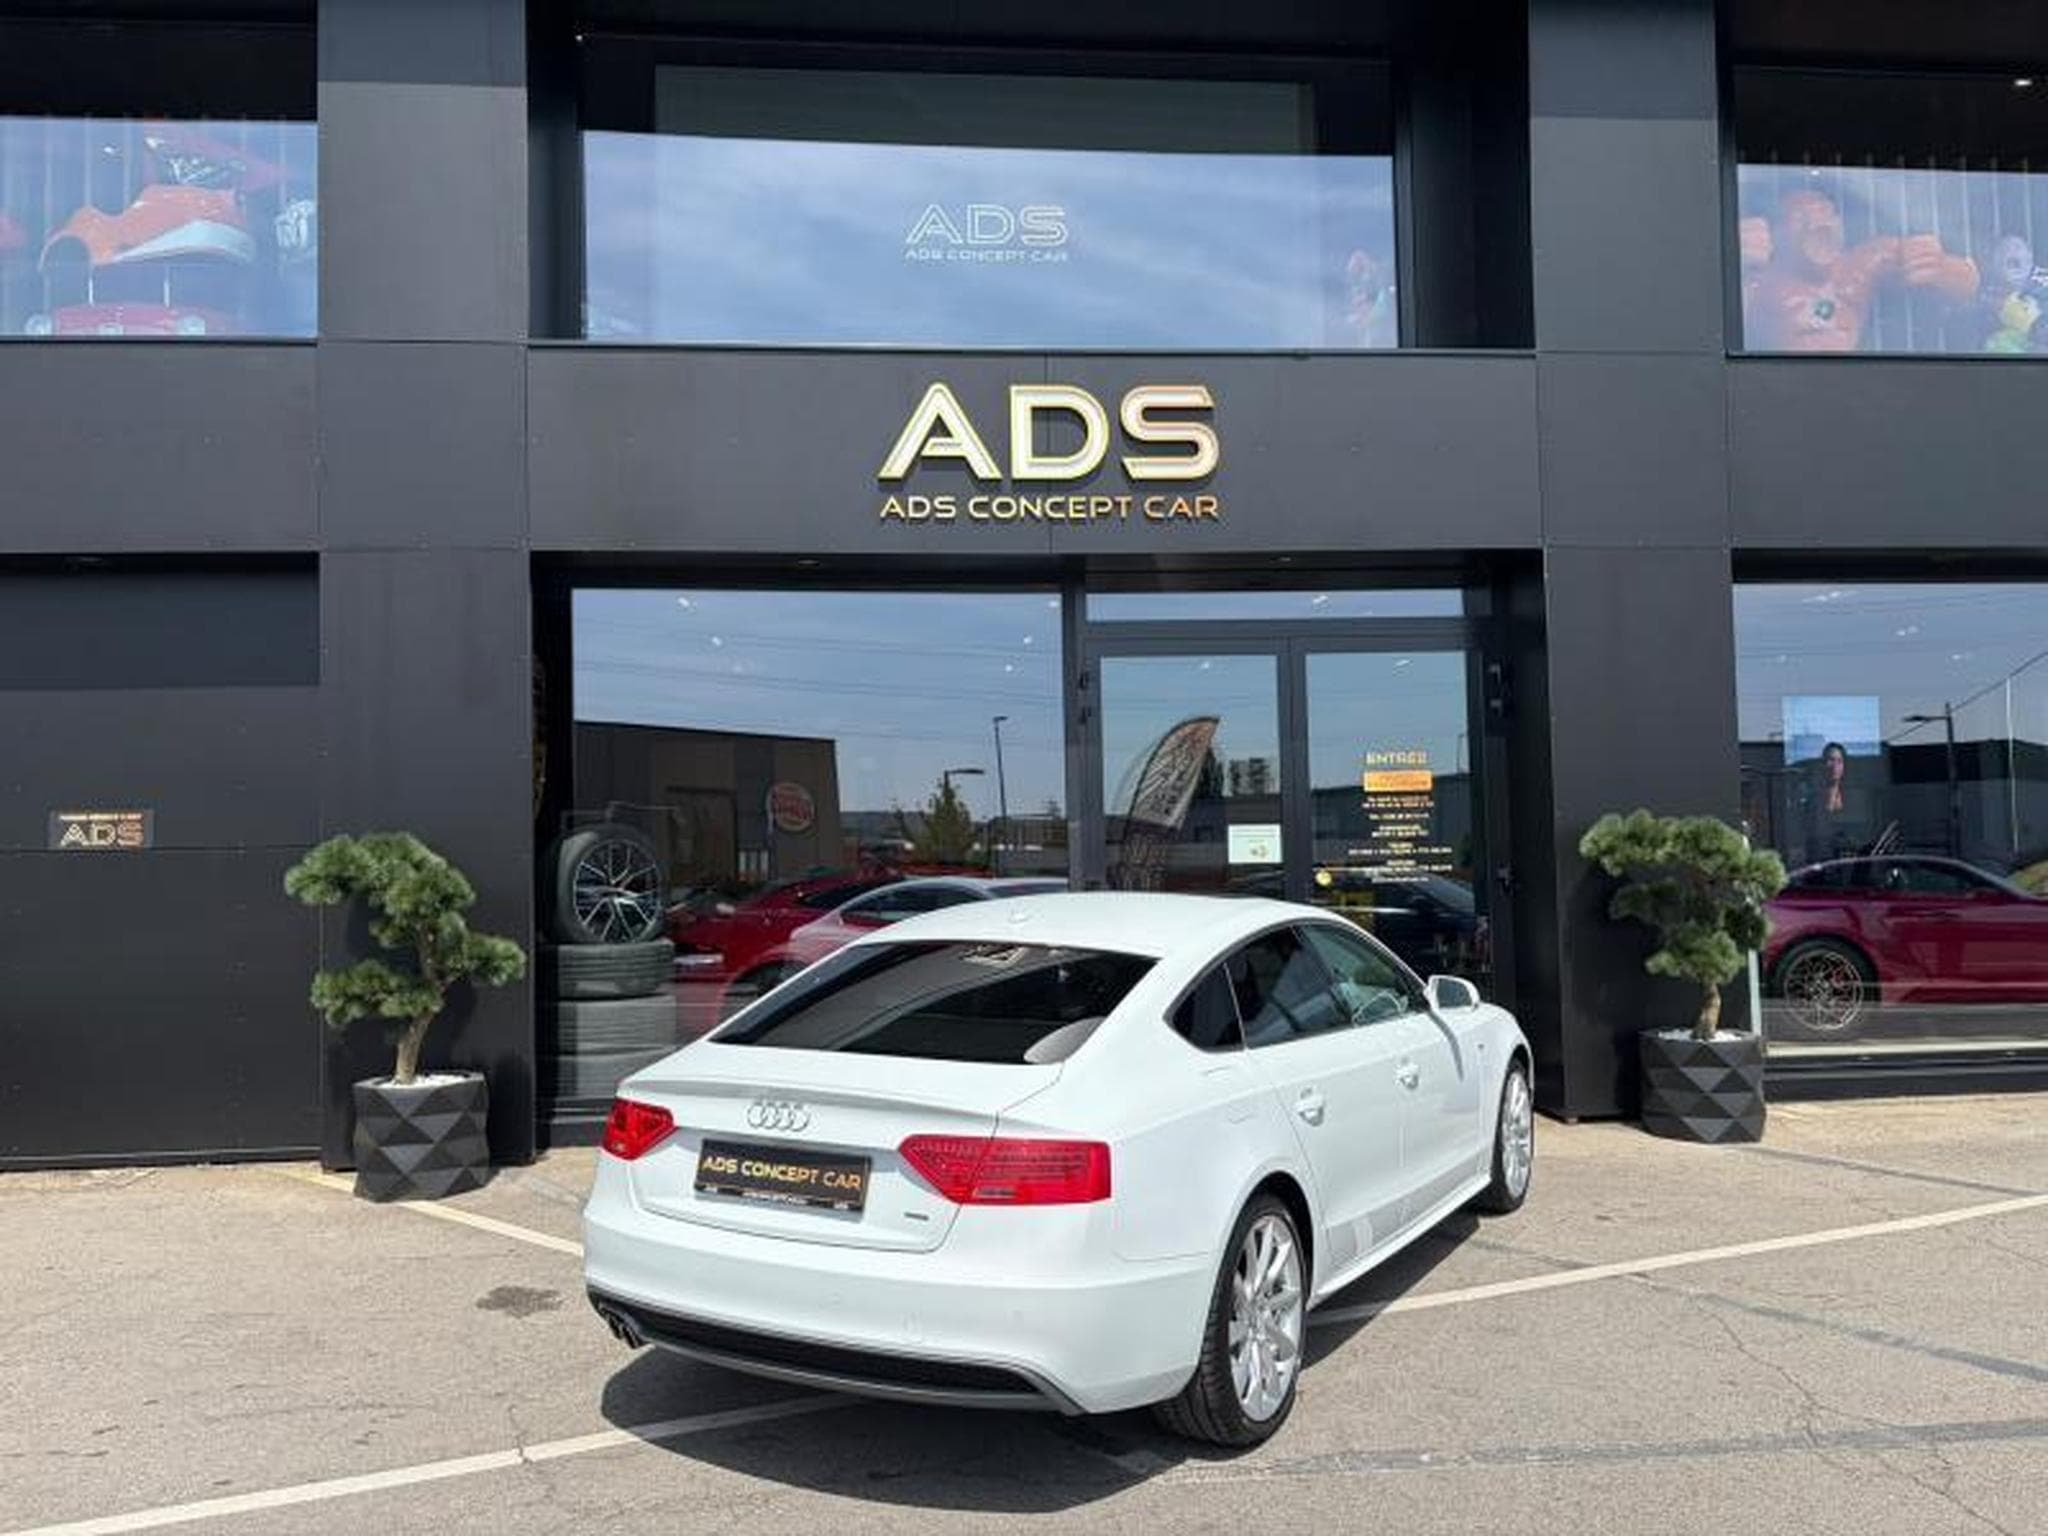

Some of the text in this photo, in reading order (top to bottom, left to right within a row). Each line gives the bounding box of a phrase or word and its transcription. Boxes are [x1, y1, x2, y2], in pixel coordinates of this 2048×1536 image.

[906, 203, 1068, 246] ADS
[905, 249, 943, 261] ADS
[947, 250, 1025, 263] CONCEPT
[877, 382, 1220, 480] ADS
[879, 496, 1220, 519] ADS CONCEPT CAR
[60, 823, 144, 847] ADS
[702, 1156, 862, 1192] ADS CONCEPT CAR
